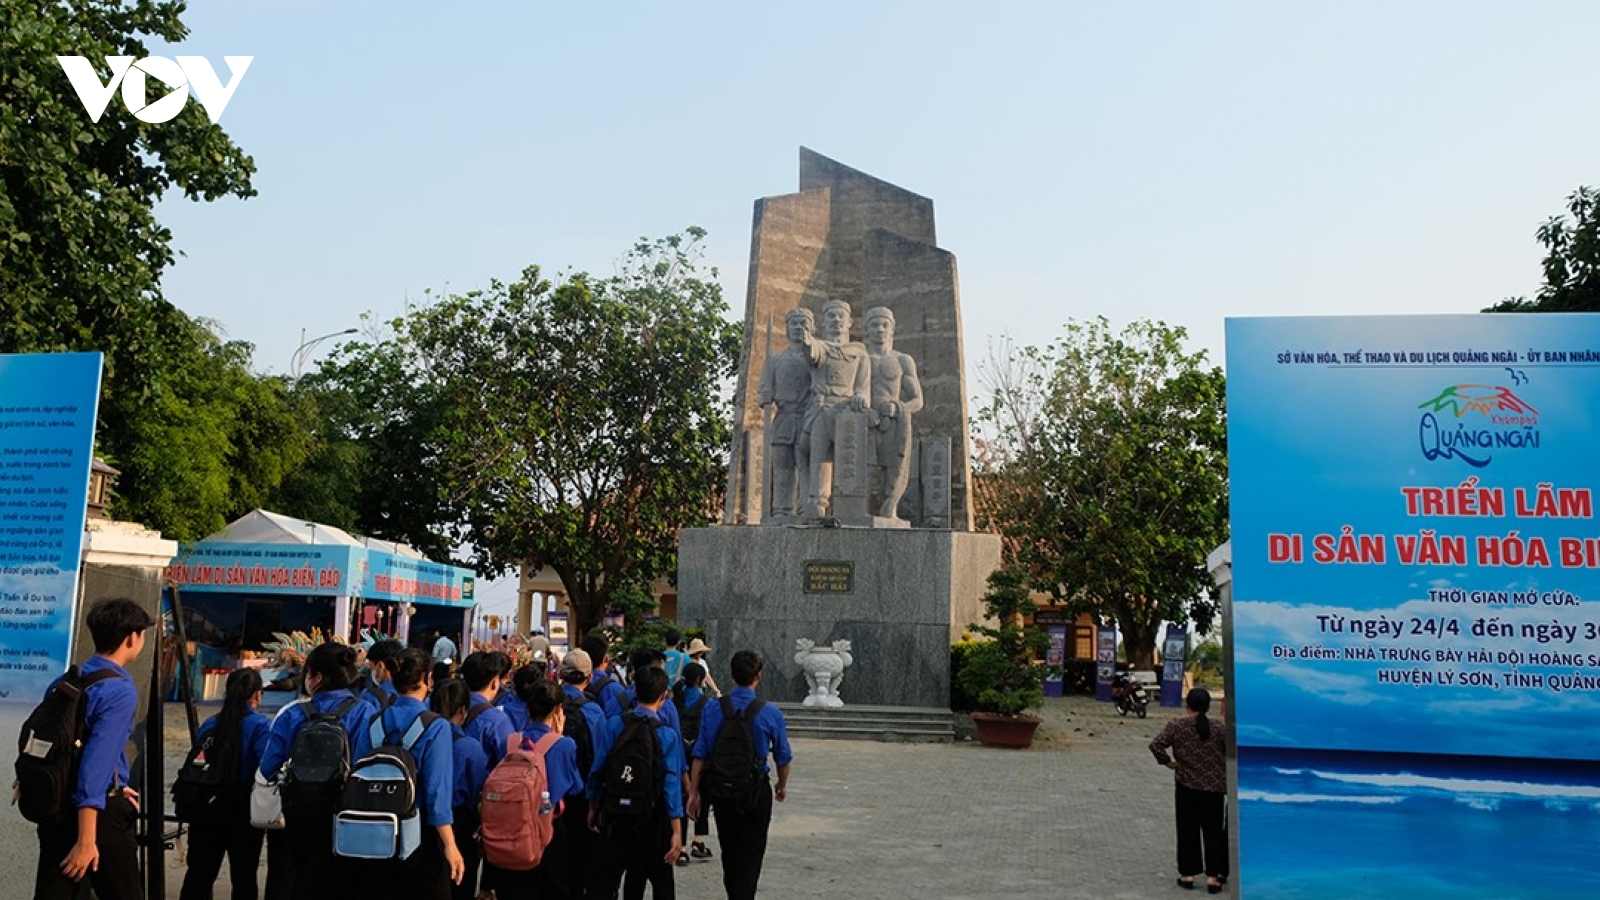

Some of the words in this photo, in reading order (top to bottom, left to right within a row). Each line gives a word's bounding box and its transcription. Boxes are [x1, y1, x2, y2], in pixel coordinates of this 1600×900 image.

[1277, 350, 1291, 364] SỞ
[1294, 350, 1314, 363] VĂN
[1317, 350, 1341, 364] HÓA,
[1365, 352, 1391, 363] THAO
[1394, 350, 1407, 363] VÀ
[1410, 352, 1424, 363] DU
[1427, 352, 1450, 366] LỊCH
[1452, 348, 1489, 364] QUẢNG
[1491, 349, 1518, 363] NGÃI
[1527, 348, 1542, 363] ỦY
[1544, 352, 1567, 363] BAN
[1569, 348, 1600, 363] NHÂN
[1494, 425, 1540, 449] NGÃI
[1402, 476, 1505, 518] TRIỂN
[1514, 482, 1593, 519] LÃM
[1268, 533, 1304, 563] DI
[1313, 525, 1387, 565] SẢN
[1394, 529, 1469, 566] VĂN
[1476, 531, 1552, 567] HÓA
[1559, 538, 1600, 569] BI
[191, 562, 212, 585] LÃM
[213, 566, 225, 586] DI
[226, 561, 247, 586] SẢN
[249, 562, 268, 587] VĂN
[270, 563, 290, 587] HÓA
[319, 562, 341, 588] ĐẢO
[1428, 589, 1467, 604] THỜI
[1470, 591, 1509, 605] GIAN
[1513, 590, 1538, 605] MỞ
[1542, 590, 1581, 606] CỬA:
[1316, 614, 1345, 634] Từ
[1350, 615, 1404, 640] ngày
[1409, 617, 1460, 639] 24/4
[1471, 616, 1515, 638] đến
[1521, 619, 1577, 644] ngày
[1583, 621, 1600, 641] 3
[1273, 644, 1297, 661] Địa
[1299, 644, 1342, 659] điểm:
[1345, 644, 1377, 660] NHÀ
[1379, 647, 1432, 662] TRƯNG
[1436, 647, 1463, 663] BÀY
[1467, 647, 1493, 664] HẢI
[1497, 649, 1524, 668] ĐỘI
[1529, 650, 1584, 667] HOÀNG
[1378, 667, 1432, 688] HUYỆN
[1438, 668, 1455, 685] LÝ
[1458, 670, 1499, 689] SƠN,
[1503, 670, 1543, 688] TỈNH
